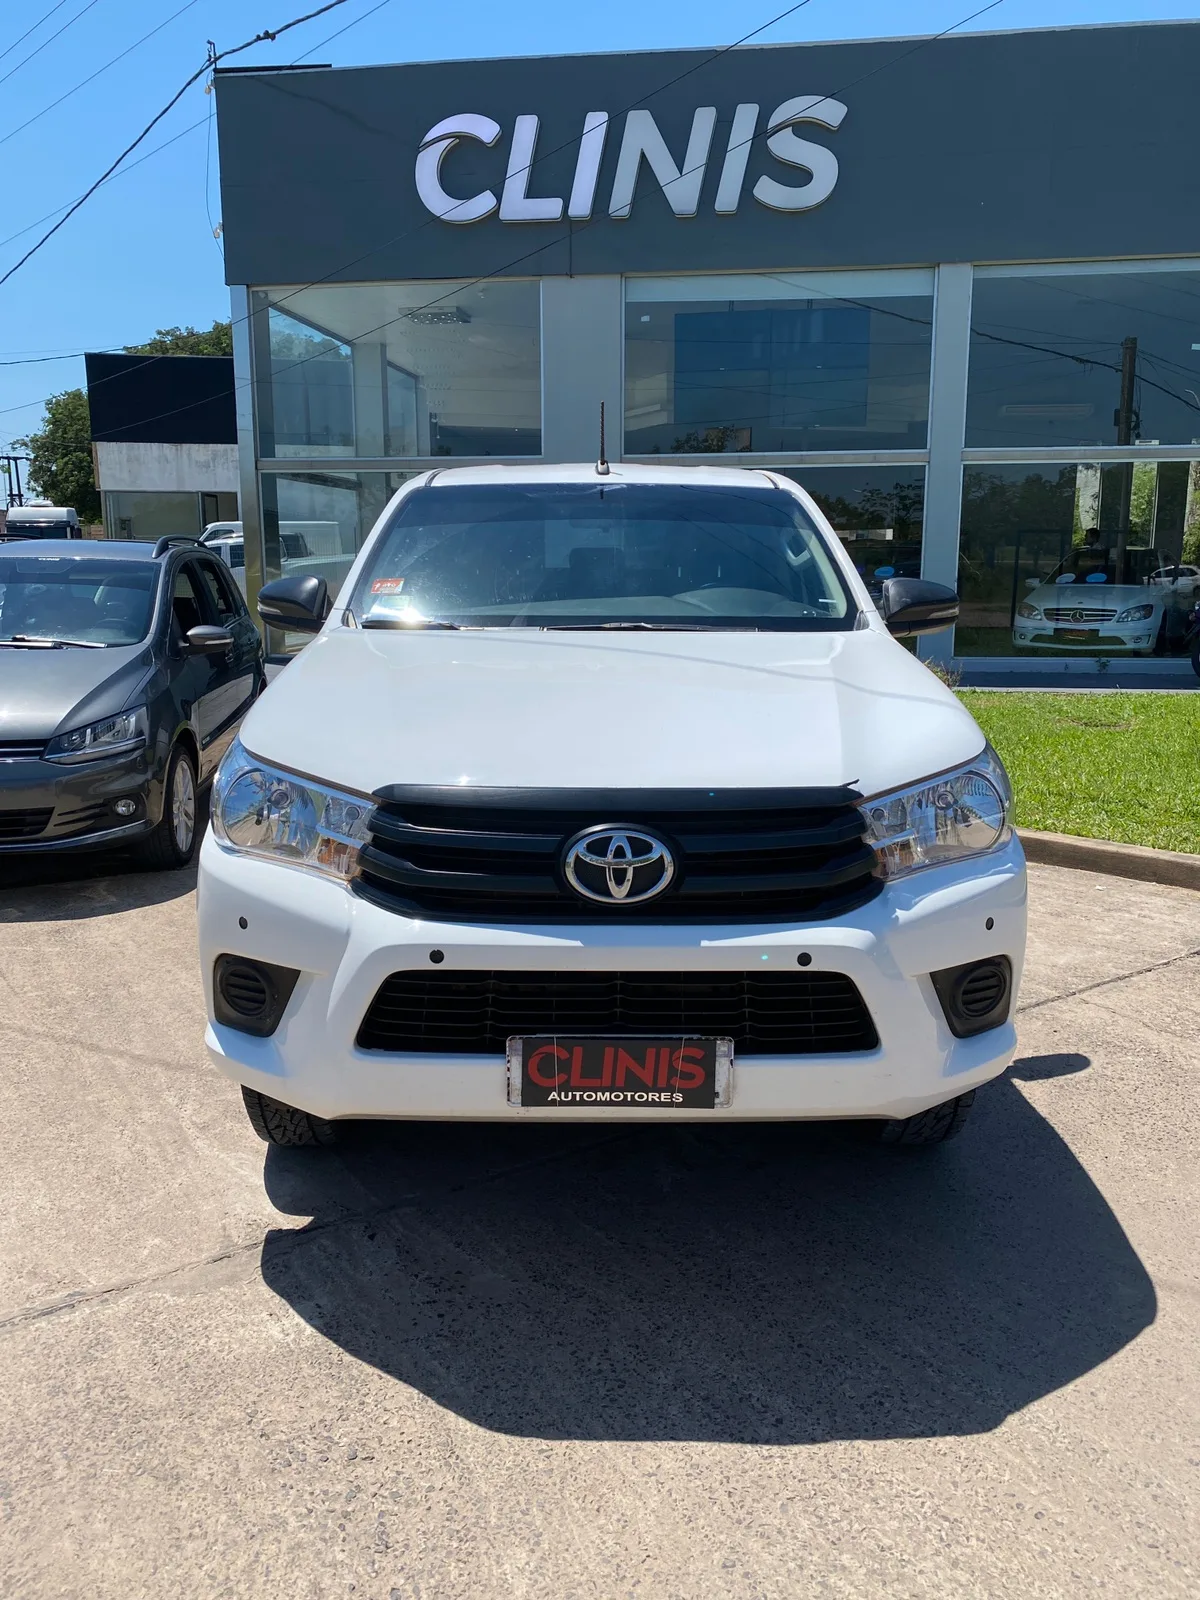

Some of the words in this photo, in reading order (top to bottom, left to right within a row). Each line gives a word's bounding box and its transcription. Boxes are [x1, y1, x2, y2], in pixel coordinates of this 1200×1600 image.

[415, 95, 848, 224] CLINIS
[528, 1045, 705, 1088] CLINIS
[547, 1091, 684, 1102] AUTOMOTORES
